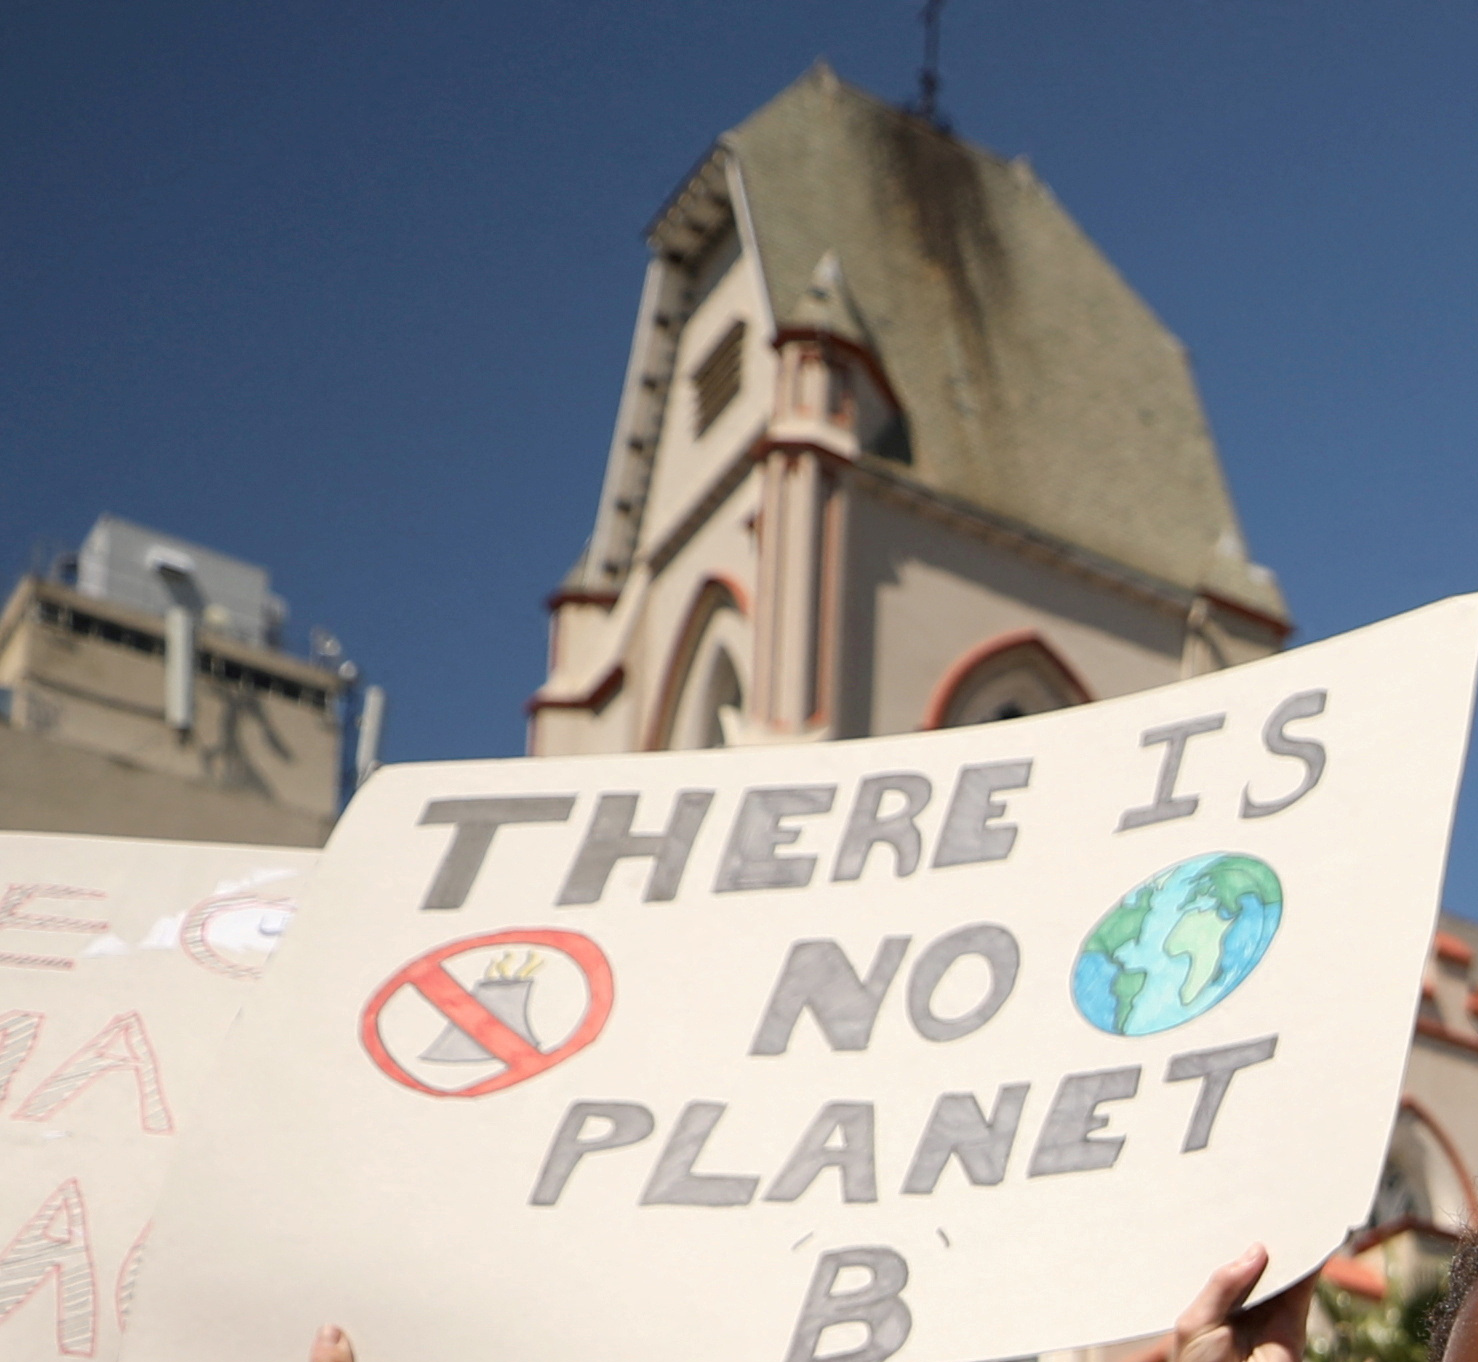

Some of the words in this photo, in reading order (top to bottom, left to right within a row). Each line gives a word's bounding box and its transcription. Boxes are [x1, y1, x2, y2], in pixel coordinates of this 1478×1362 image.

[417, 757, 1035, 911] THERE
[1114, 688, 1330, 832] IS
[750, 921, 1022, 1056] NO
[529, 1034, 1280, 1208] PLANET
